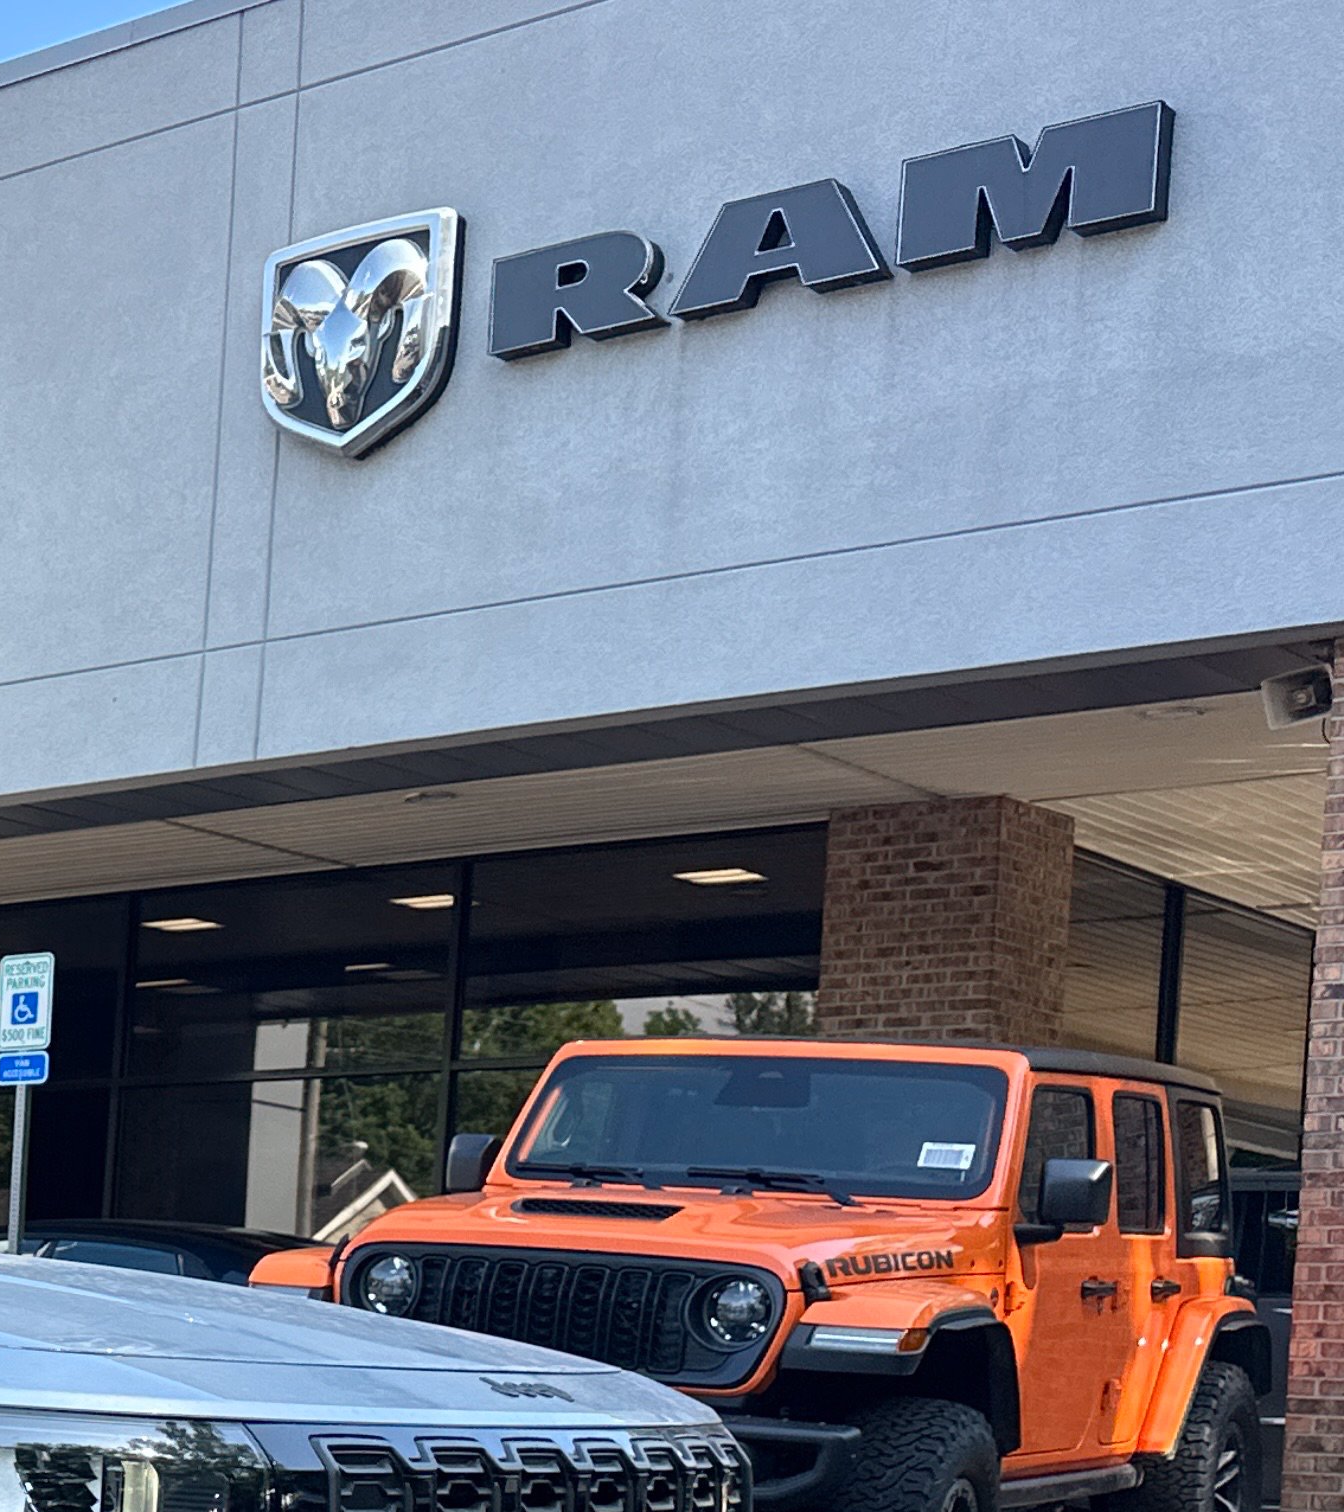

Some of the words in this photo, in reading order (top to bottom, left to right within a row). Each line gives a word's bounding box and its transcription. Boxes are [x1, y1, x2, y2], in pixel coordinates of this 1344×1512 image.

[487, 99, 1176, 361] RAM
[5, 960, 49, 976] RESERVED
[6, 976, 46, 990] PARKING
[825, 1249, 955, 1278] RUBICON
